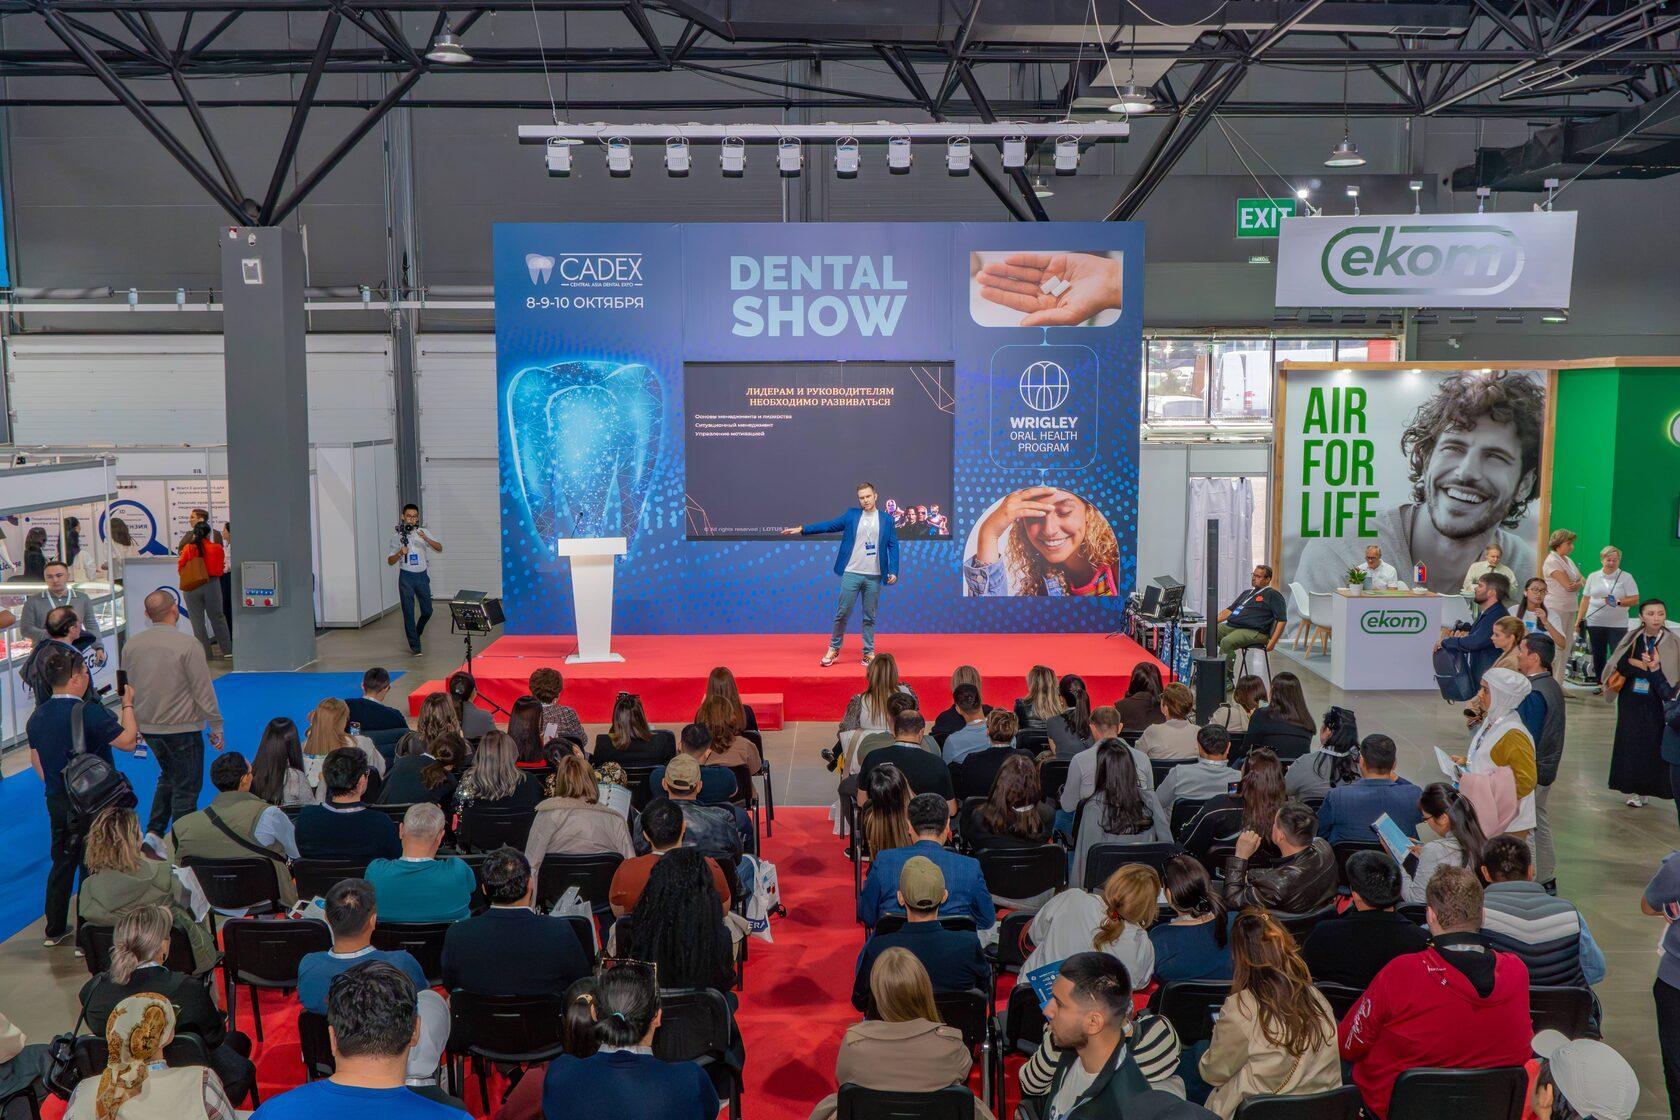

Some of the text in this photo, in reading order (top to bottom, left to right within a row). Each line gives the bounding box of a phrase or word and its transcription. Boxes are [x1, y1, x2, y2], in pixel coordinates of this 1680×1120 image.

[1240, 207, 1293, 229] EXIT
[1341, 226, 1503, 277] ekom
[560, 257, 643, 281] CADEX
[730, 255, 908, 291] DENTAL
[526, 296, 644, 309] 8-9-10 ОКТЯБРЯ
[731, 295, 908, 338] SHOW
[746, 387, 895, 397] ЛИДЕРАМ И РУКОВОДИТЕЛЯМ
[749, 398, 891, 407] НЕОБХОДИМО РАЗВИВАТЬСЯ
[1302, 386, 1368, 434] AIR
[1009, 416, 1079, 429] WRIGLEY
[1010, 431, 1078, 441] ORAL HEALTH
[1018, 443, 1069, 453] PROGRAM
[1302, 439, 1375, 486] FOR
[1300, 491, 1380, 538] LIFE
[1367, 610, 1420, 628] ekom
